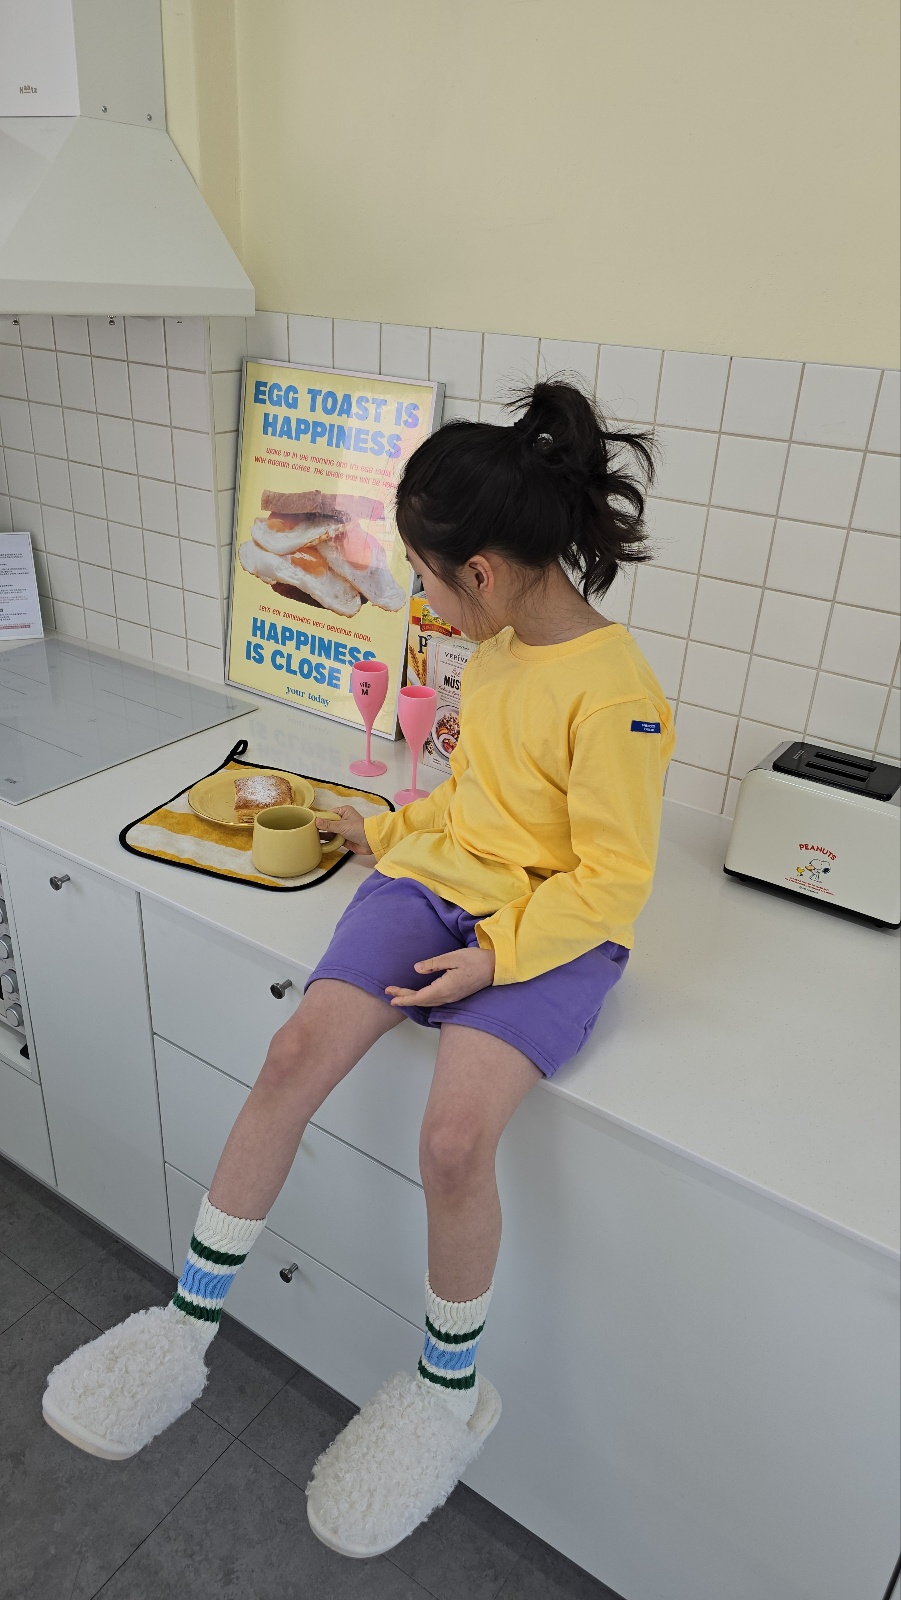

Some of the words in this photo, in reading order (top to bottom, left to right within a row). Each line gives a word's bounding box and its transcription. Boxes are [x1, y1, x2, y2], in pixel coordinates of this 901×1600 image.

[254, 381, 299, 410] EGG
[307, 388, 387, 423] TOAST
[394, 401, 420, 429] IS
[262, 412, 403, 459] HAPPINESS
[245, 640, 264, 665] IS
[270, 649, 341, 690] CLOSE
[443, 674, 462, 690] MÜS
[286, 686, 305, 698] your
[308, 691, 331, 707] today
[799, 843, 837, 861] PEANUTS
